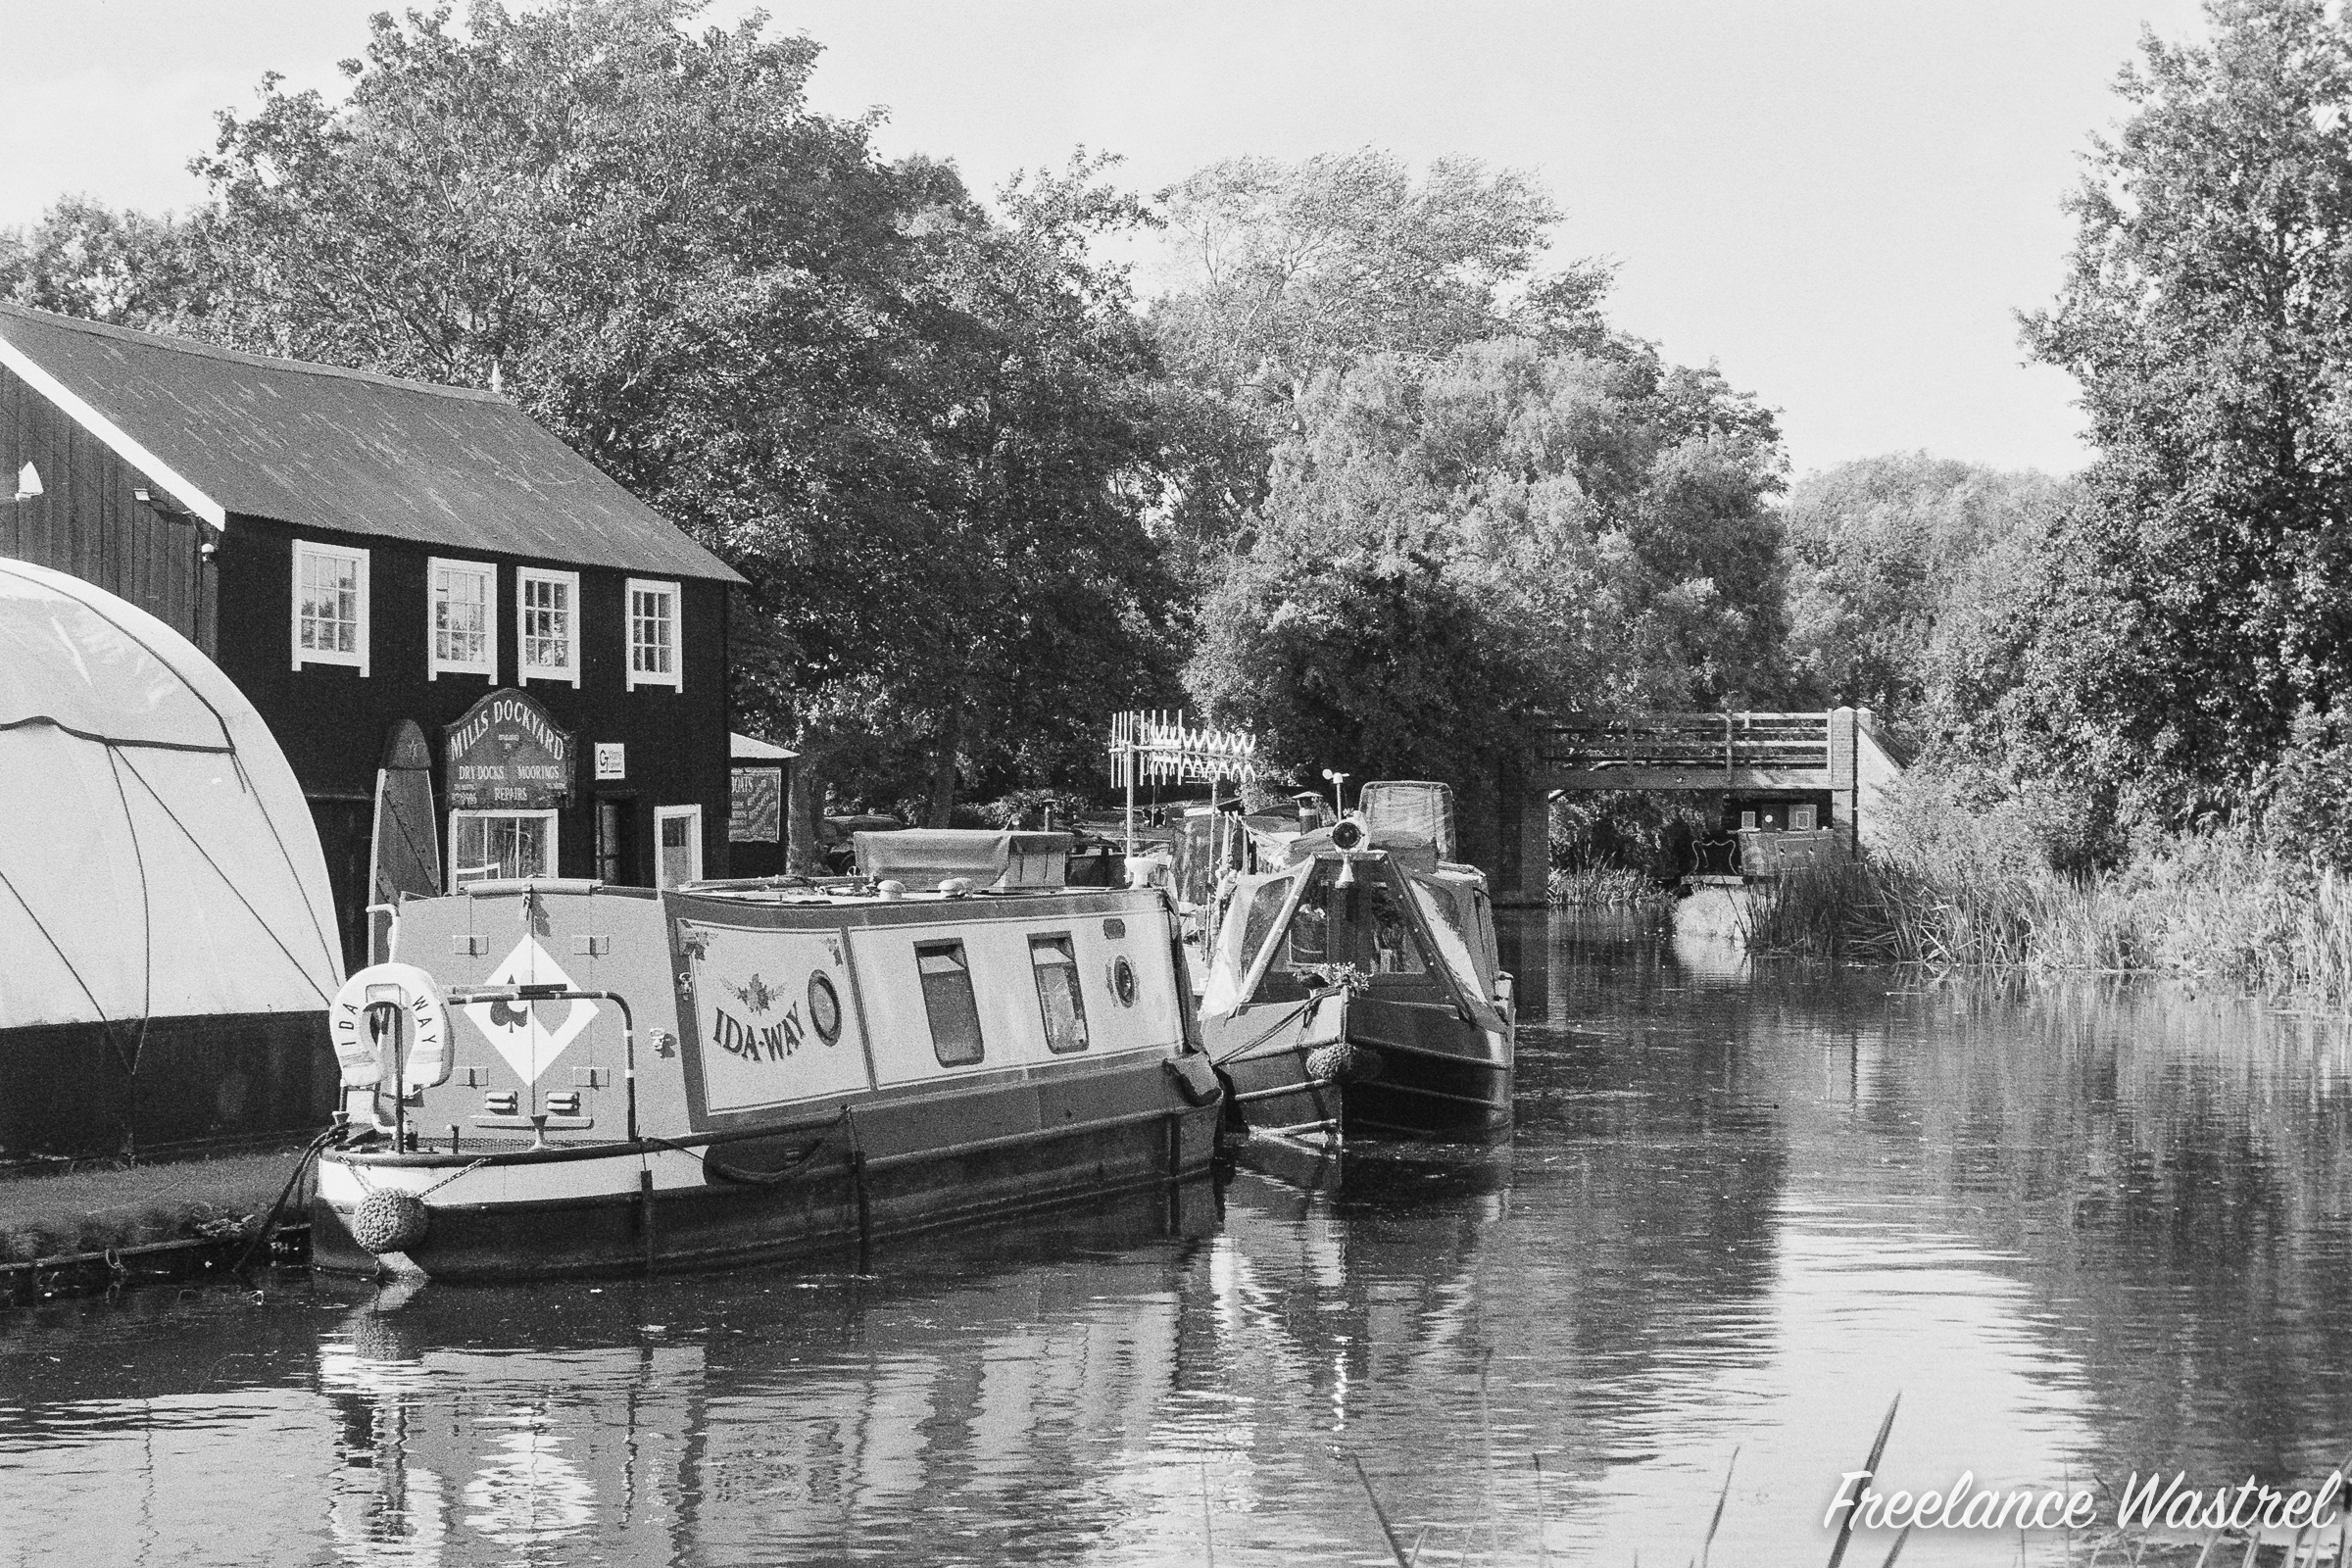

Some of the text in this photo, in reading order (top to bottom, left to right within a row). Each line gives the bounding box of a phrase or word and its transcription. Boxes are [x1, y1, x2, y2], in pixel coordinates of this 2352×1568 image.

[451, 699, 564, 760] MILLS DOCKYARD
[459, 764, 560, 780] DRY DOCKS MOORINGS
[494, 787, 528, 801] REPAIRS
[338, 995, 437, 1046] IDA WAY
